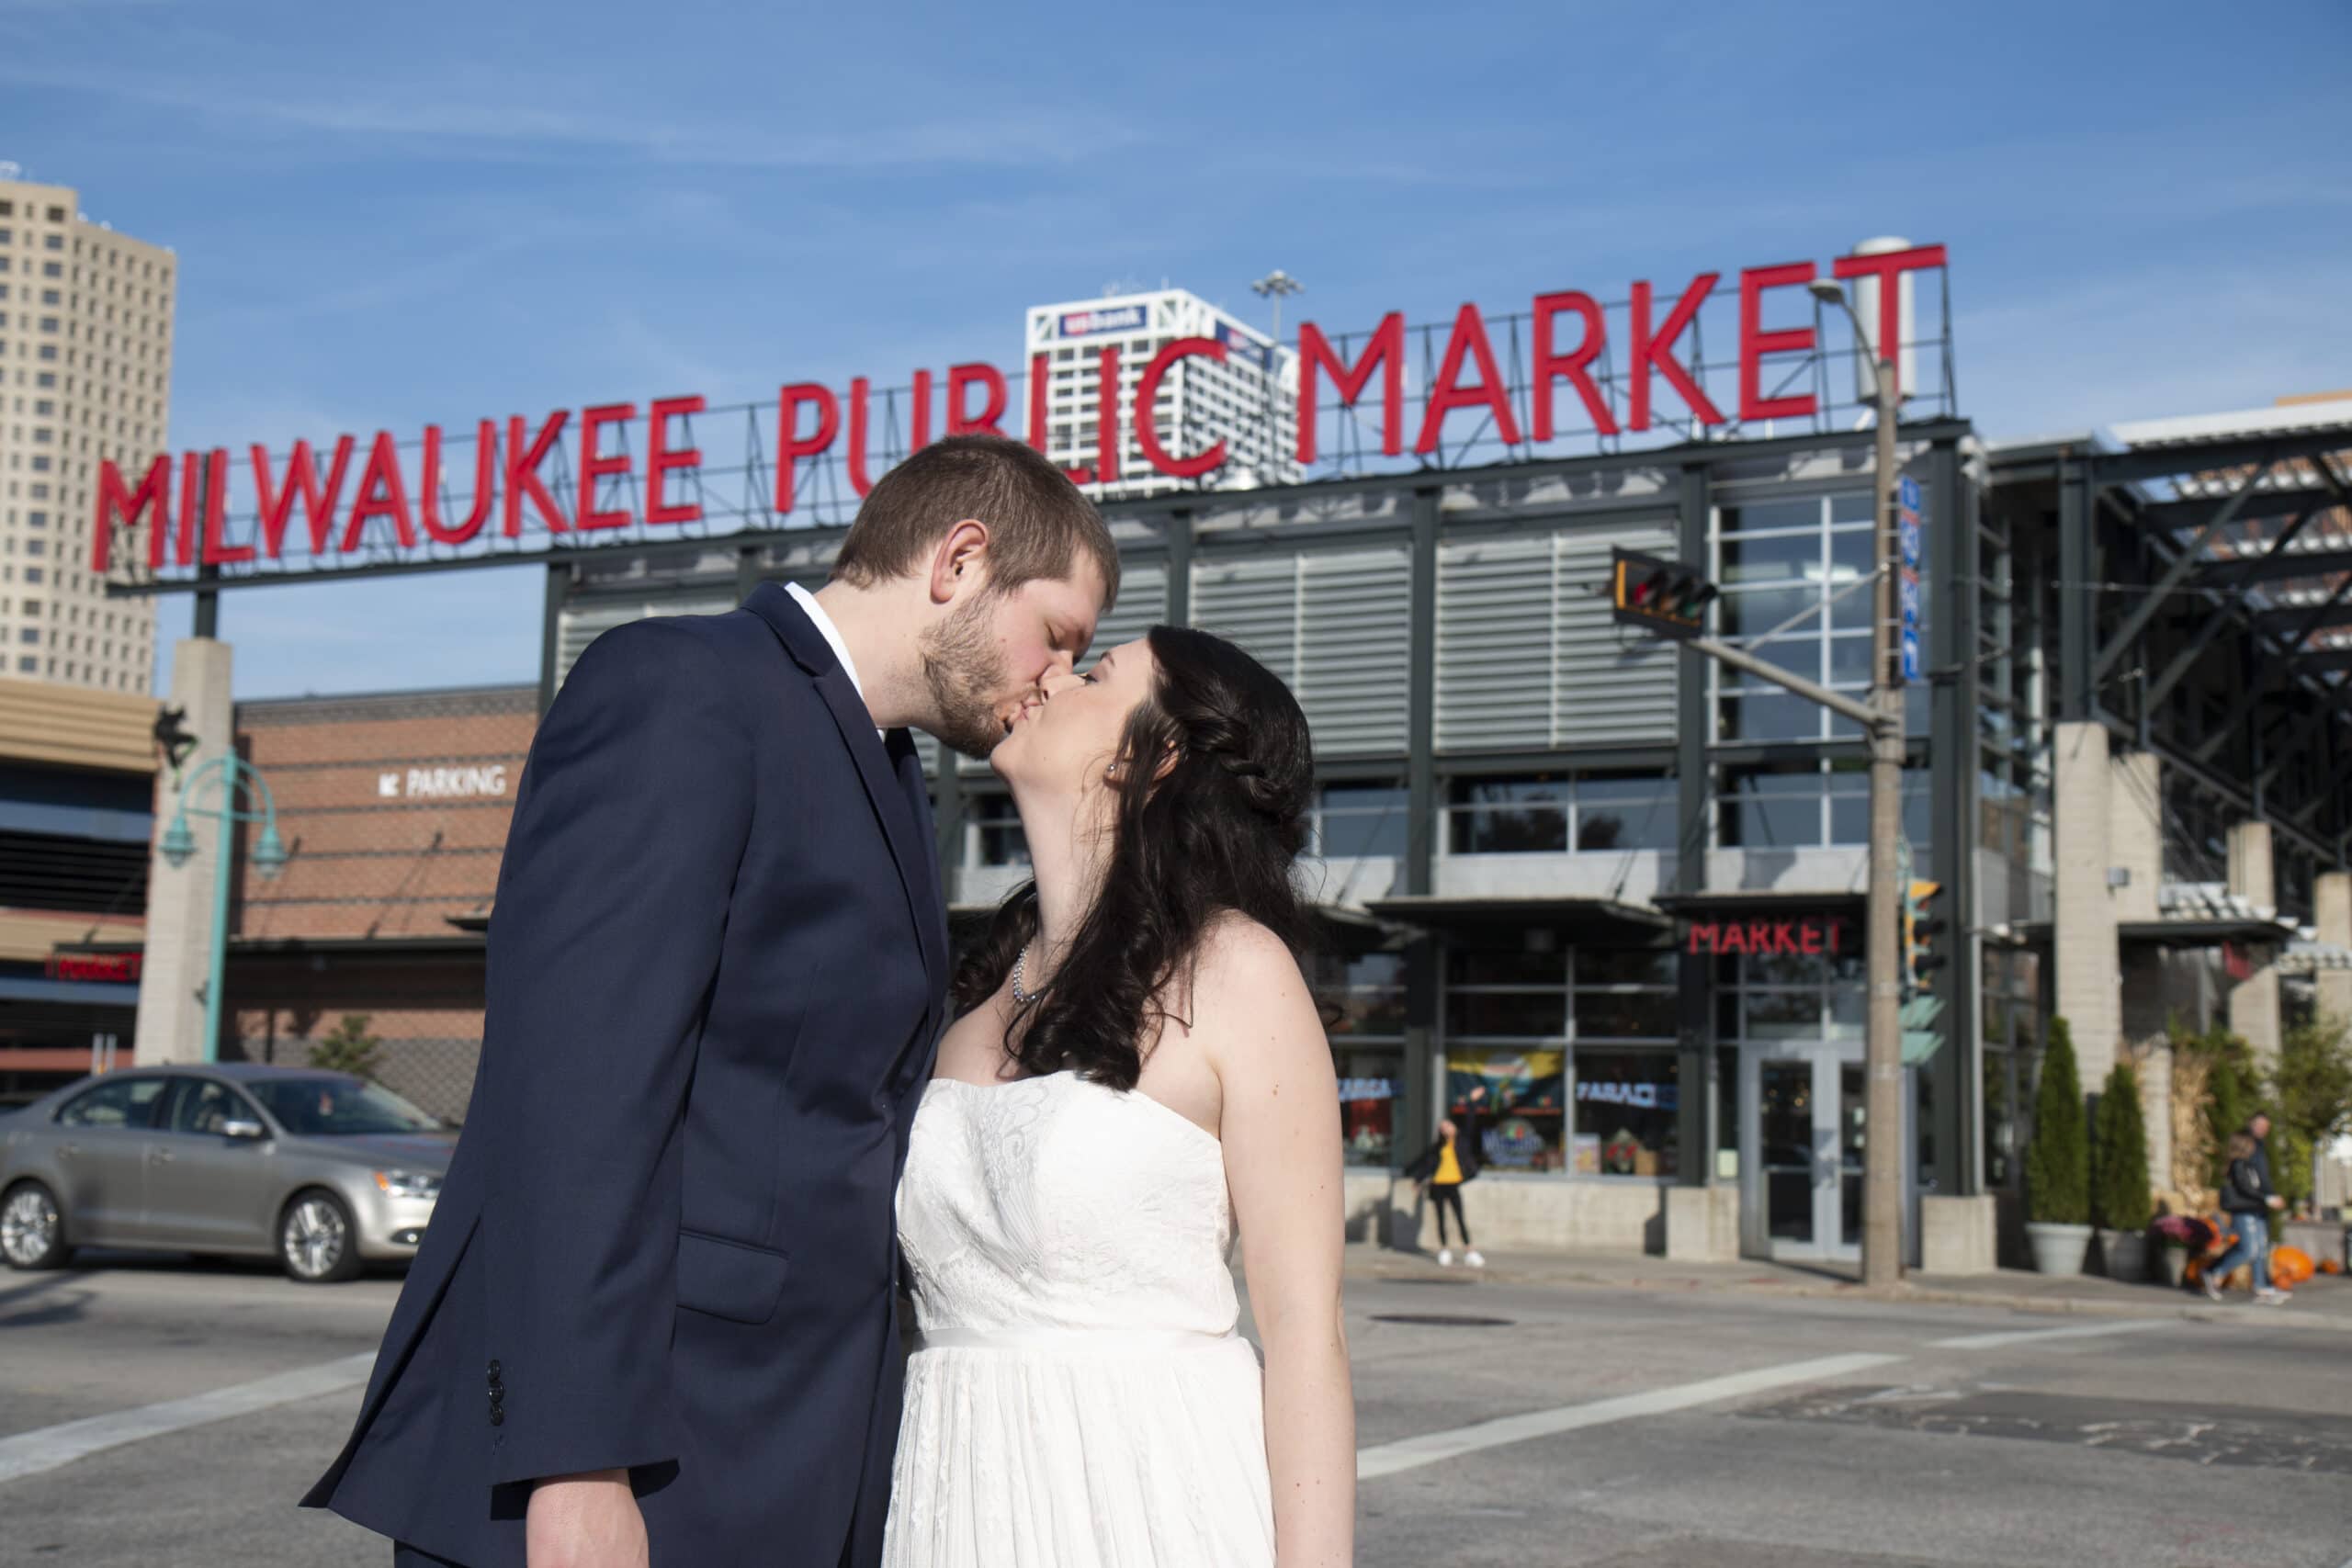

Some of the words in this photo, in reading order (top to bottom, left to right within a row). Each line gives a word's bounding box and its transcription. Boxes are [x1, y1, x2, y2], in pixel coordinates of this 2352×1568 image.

[92, 395, 707, 572] MILWAUKEE
[775, 337, 1227, 513] PUBLIC
[1297, 243, 1949, 465] MARKET
[406, 764, 506, 797] PARKING
